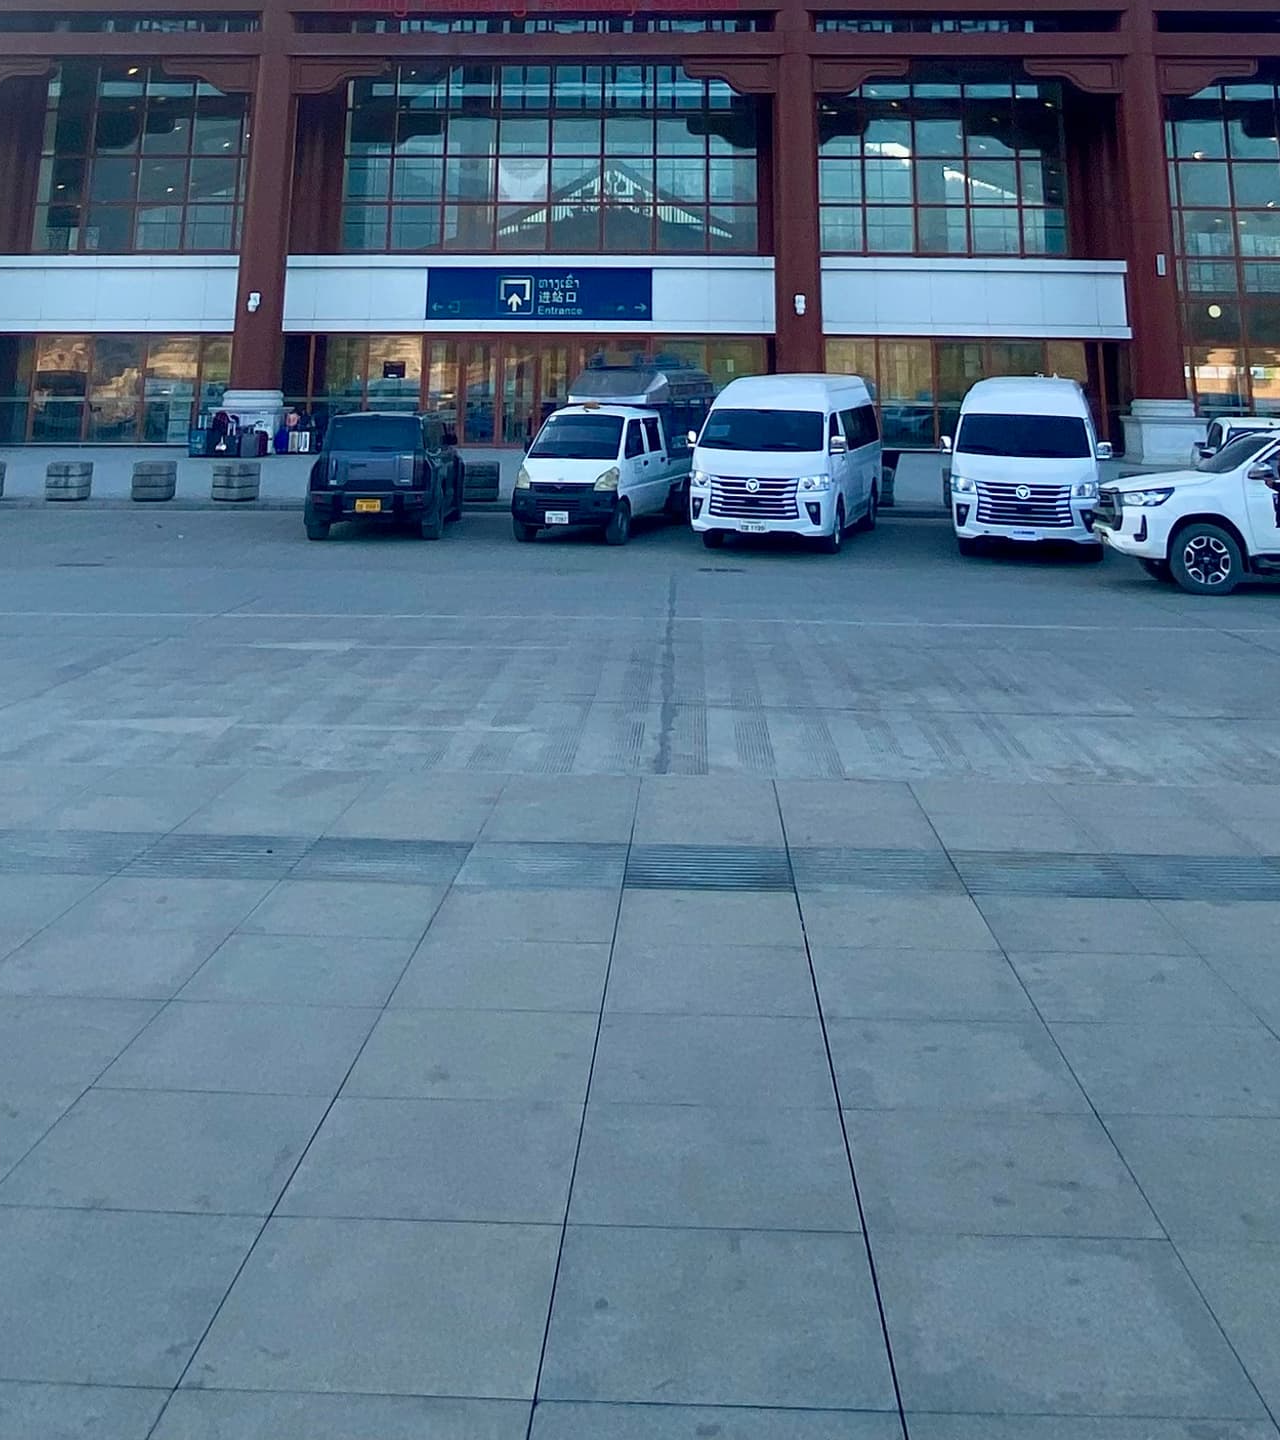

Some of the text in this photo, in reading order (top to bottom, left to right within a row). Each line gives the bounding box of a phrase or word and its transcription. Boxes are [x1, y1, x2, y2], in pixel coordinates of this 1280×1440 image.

[538, 291, 577, 304] 进站口
[537, 305, 583, 316] Entrance
